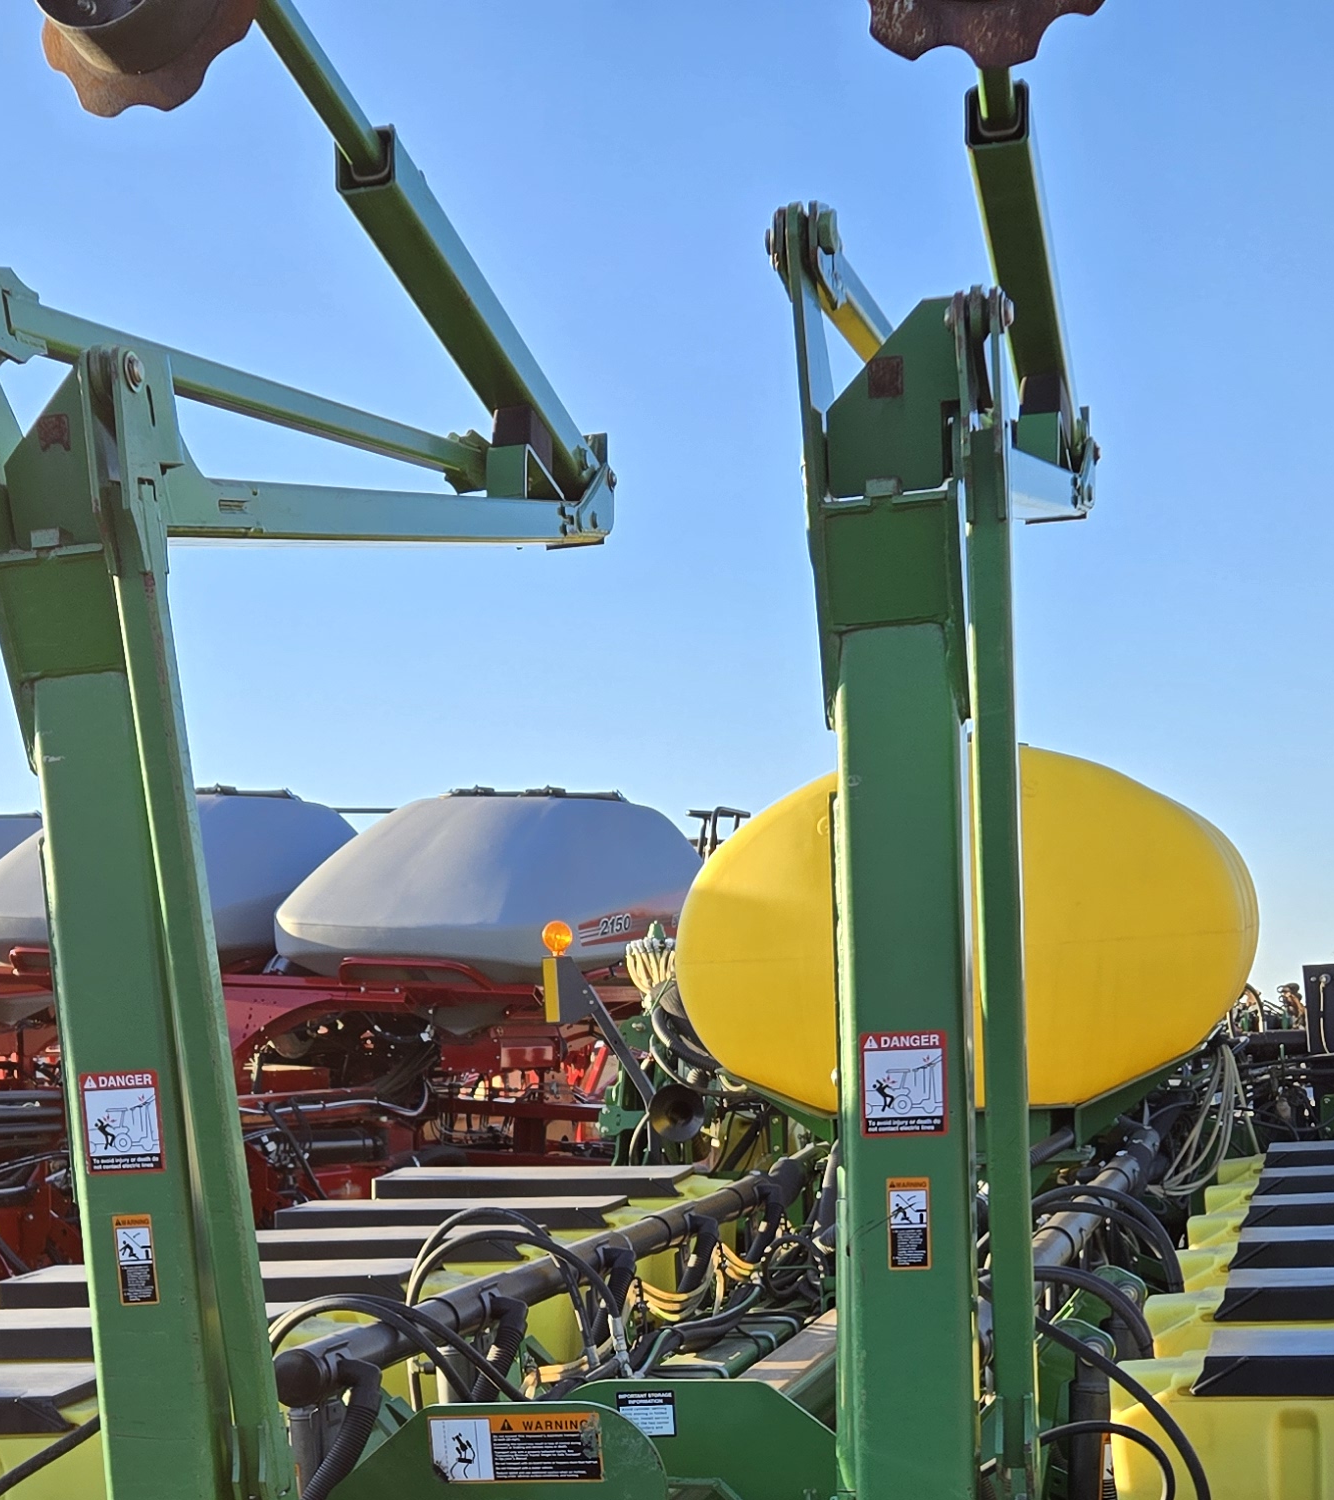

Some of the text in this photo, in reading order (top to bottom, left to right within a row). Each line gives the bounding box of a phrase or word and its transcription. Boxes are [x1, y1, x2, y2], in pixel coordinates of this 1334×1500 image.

[599, 913, 632, 936] 2150
[880, 1034, 940, 1048] DANGER
[98, 1073, 153, 1088] DANGER
[121, 1218, 150, 1226] WARNING
